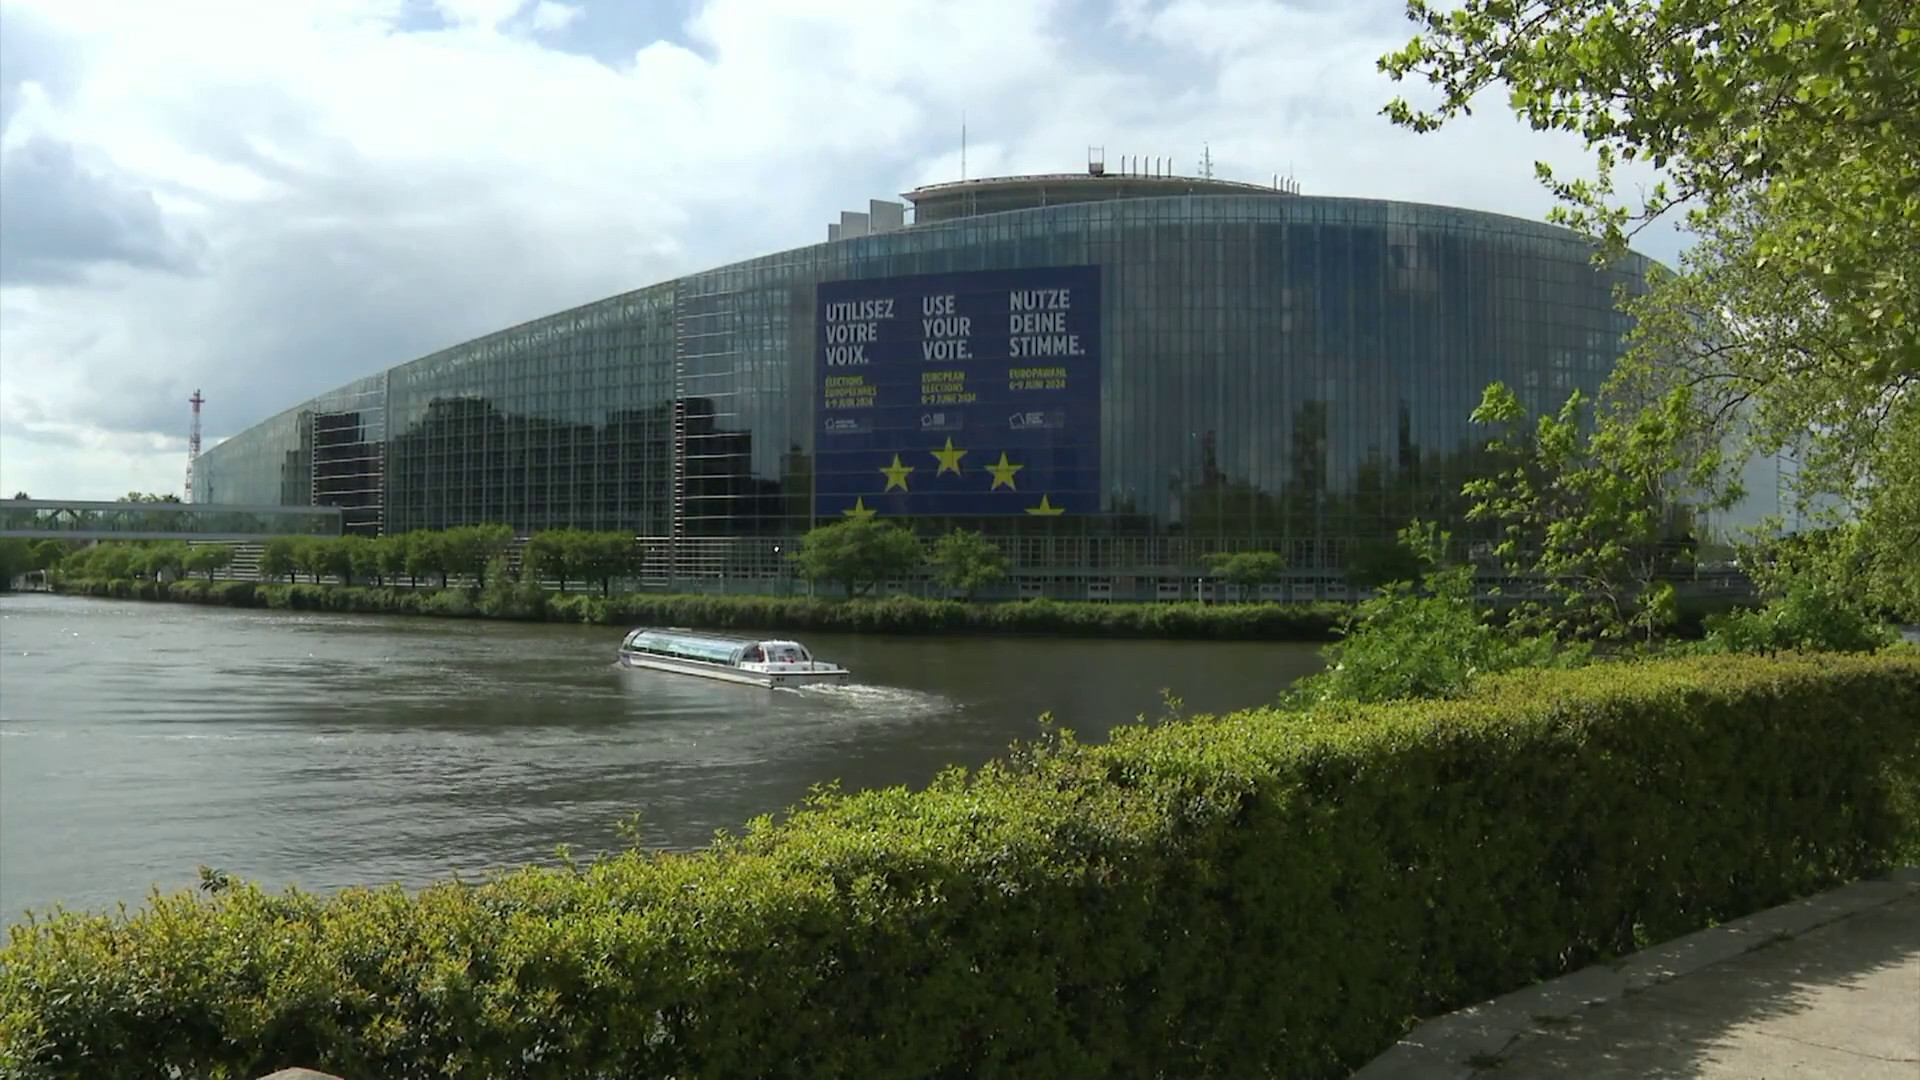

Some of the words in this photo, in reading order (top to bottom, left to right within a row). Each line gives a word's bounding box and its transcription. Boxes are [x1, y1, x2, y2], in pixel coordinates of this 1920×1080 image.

[825, 299, 894, 322] UTILISEZ
[922, 295, 955, 316] USE
[1009, 289, 1070, 311] NUTZE
[825, 322, 877, 344] VOTRE
[922, 316, 971, 338] YOUR
[1009, 312, 1066, 334] DEINE
[825, 344, 869, 366] VOIX.
[922, 339, 973, 361] VOTE.
[1009, 334, 1085, 357] STIMME.
[921, 371, 965, 383] EUROPEAN
[1009, 367, 1067, 379] EUROPAWAHL
[921, 383, 964, 394] ELECTIONS
